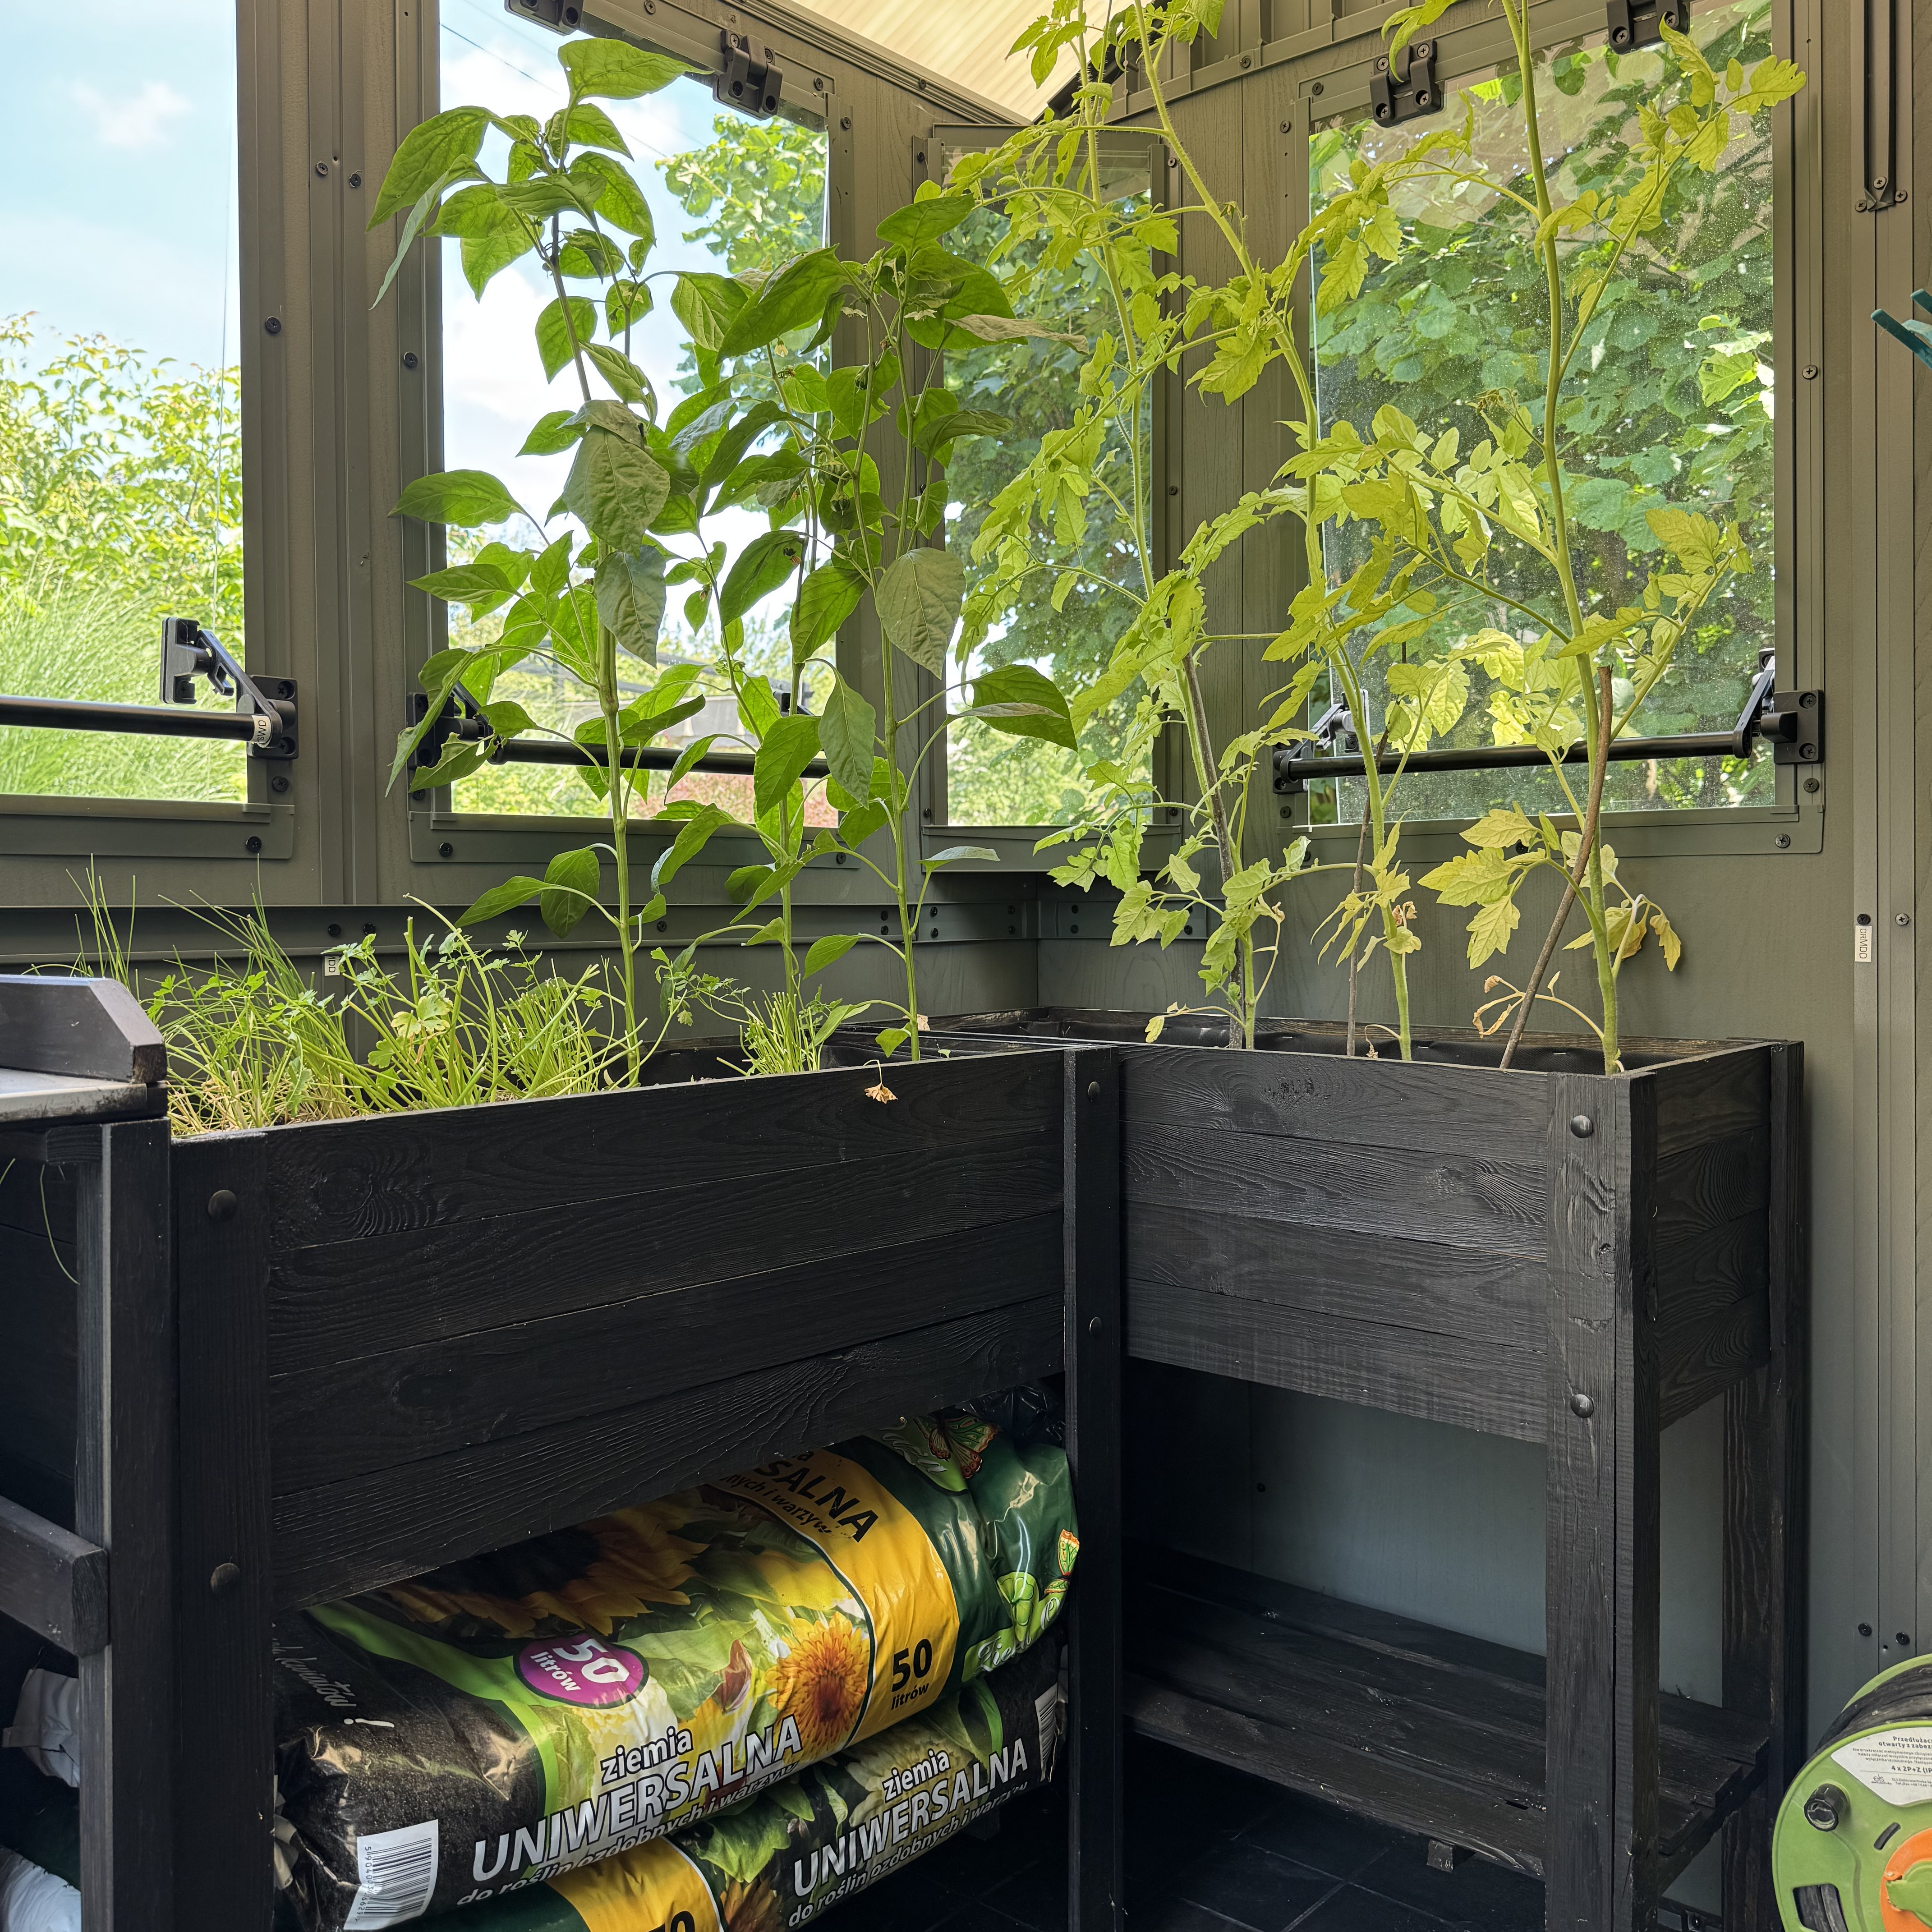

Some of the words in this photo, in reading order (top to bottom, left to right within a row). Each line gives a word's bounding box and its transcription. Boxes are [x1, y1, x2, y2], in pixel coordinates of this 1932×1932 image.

[1859, 929, 1868, 959] DRMDD
[771, 1495, 832, 1533] warzyw
[530, 1651, 581, 1691] litrów
[552, 1638, 630, 1683] 50
[891, 1639, 932, 1692] 50
[891, 1683, 929, 1710] litrów
[601, 1726, 693, 1785] ziemia
[883, 1749, 951, 1802] ziemia
[473, 1714, 802, 1881] UNIWERSALNA
[794, 1738, 1028, 1896] UNIWERSALNA
[457, 1887, 493, 1905] do
[577, 1804, 704, 1868] ozdobnych
[707, 1797, 717, 1813] i
[788, 1904, 814, 1927] do
[817, 1872, 867, 1911] roślin
[871, 1817, 959, 1878] ozdobnych
[961, 1809, 969, 1826] i
